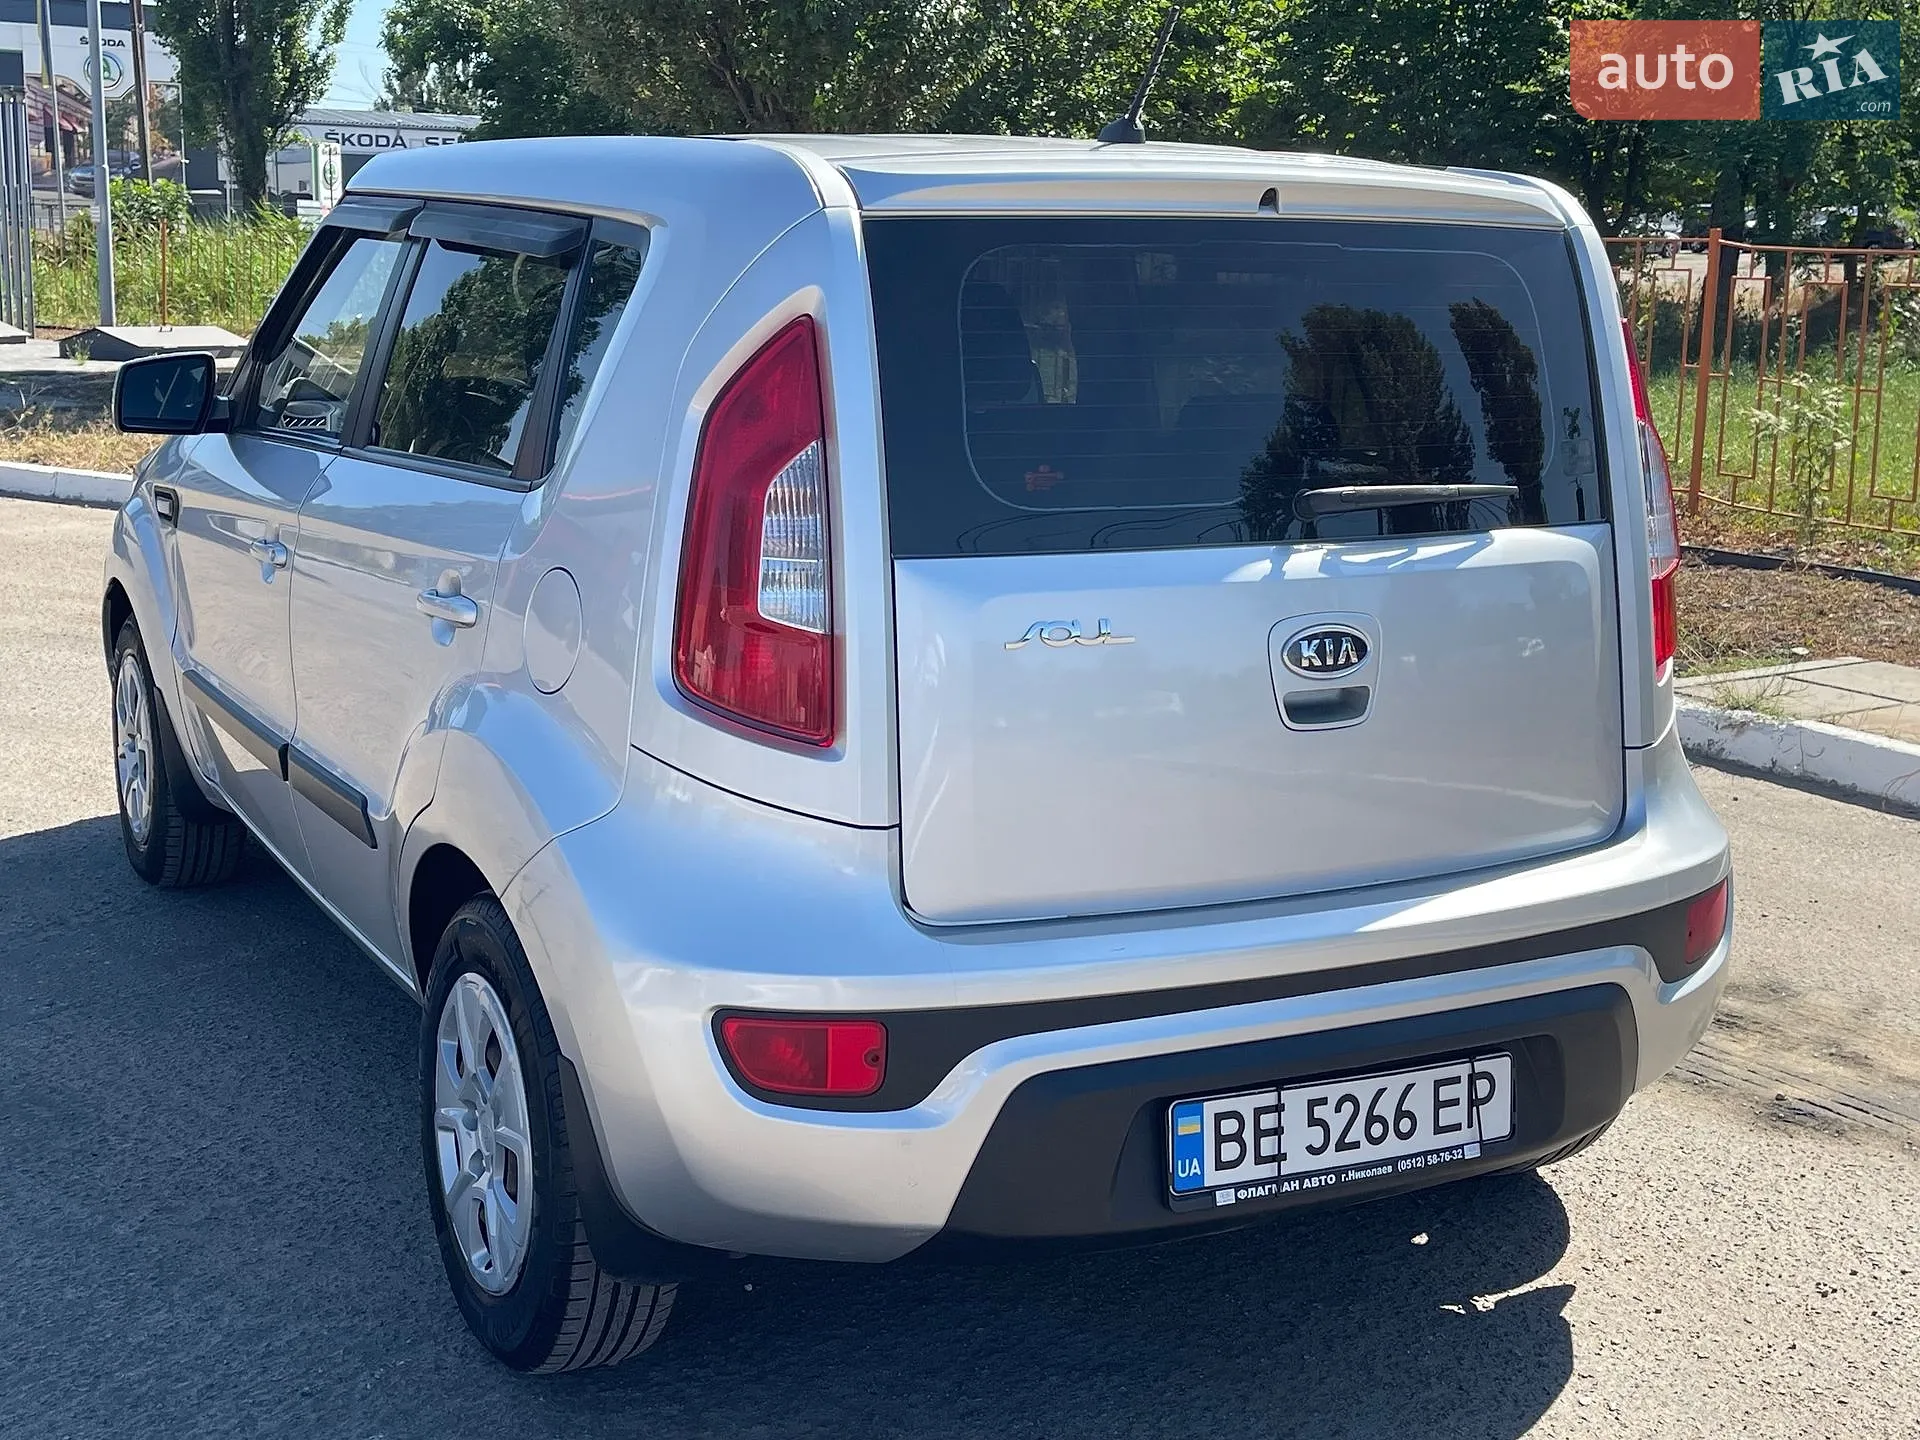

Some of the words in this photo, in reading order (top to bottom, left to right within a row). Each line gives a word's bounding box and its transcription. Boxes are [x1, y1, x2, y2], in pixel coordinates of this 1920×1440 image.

[324, 129, 408, 149] ŠKODA
[1004, 617, 1136, 650] SOUL
[1299, 636, 1359, 668] KIA
[1214, 1103, 1287, 1171] BE
[1305, 1083, 1418, 1156] 5266
[1433, 1071, 1496, 1135] EP
[1177, 1157, 1201, 1178] UA
[1303, 1173, 1336, 1190] АВТО
[1341, 1164, 1393, 1182] г.Николаев
[1397, 1156, 1425, 1172] (0512)
[1427, 1148, 1463, 1166] 58-76-32
